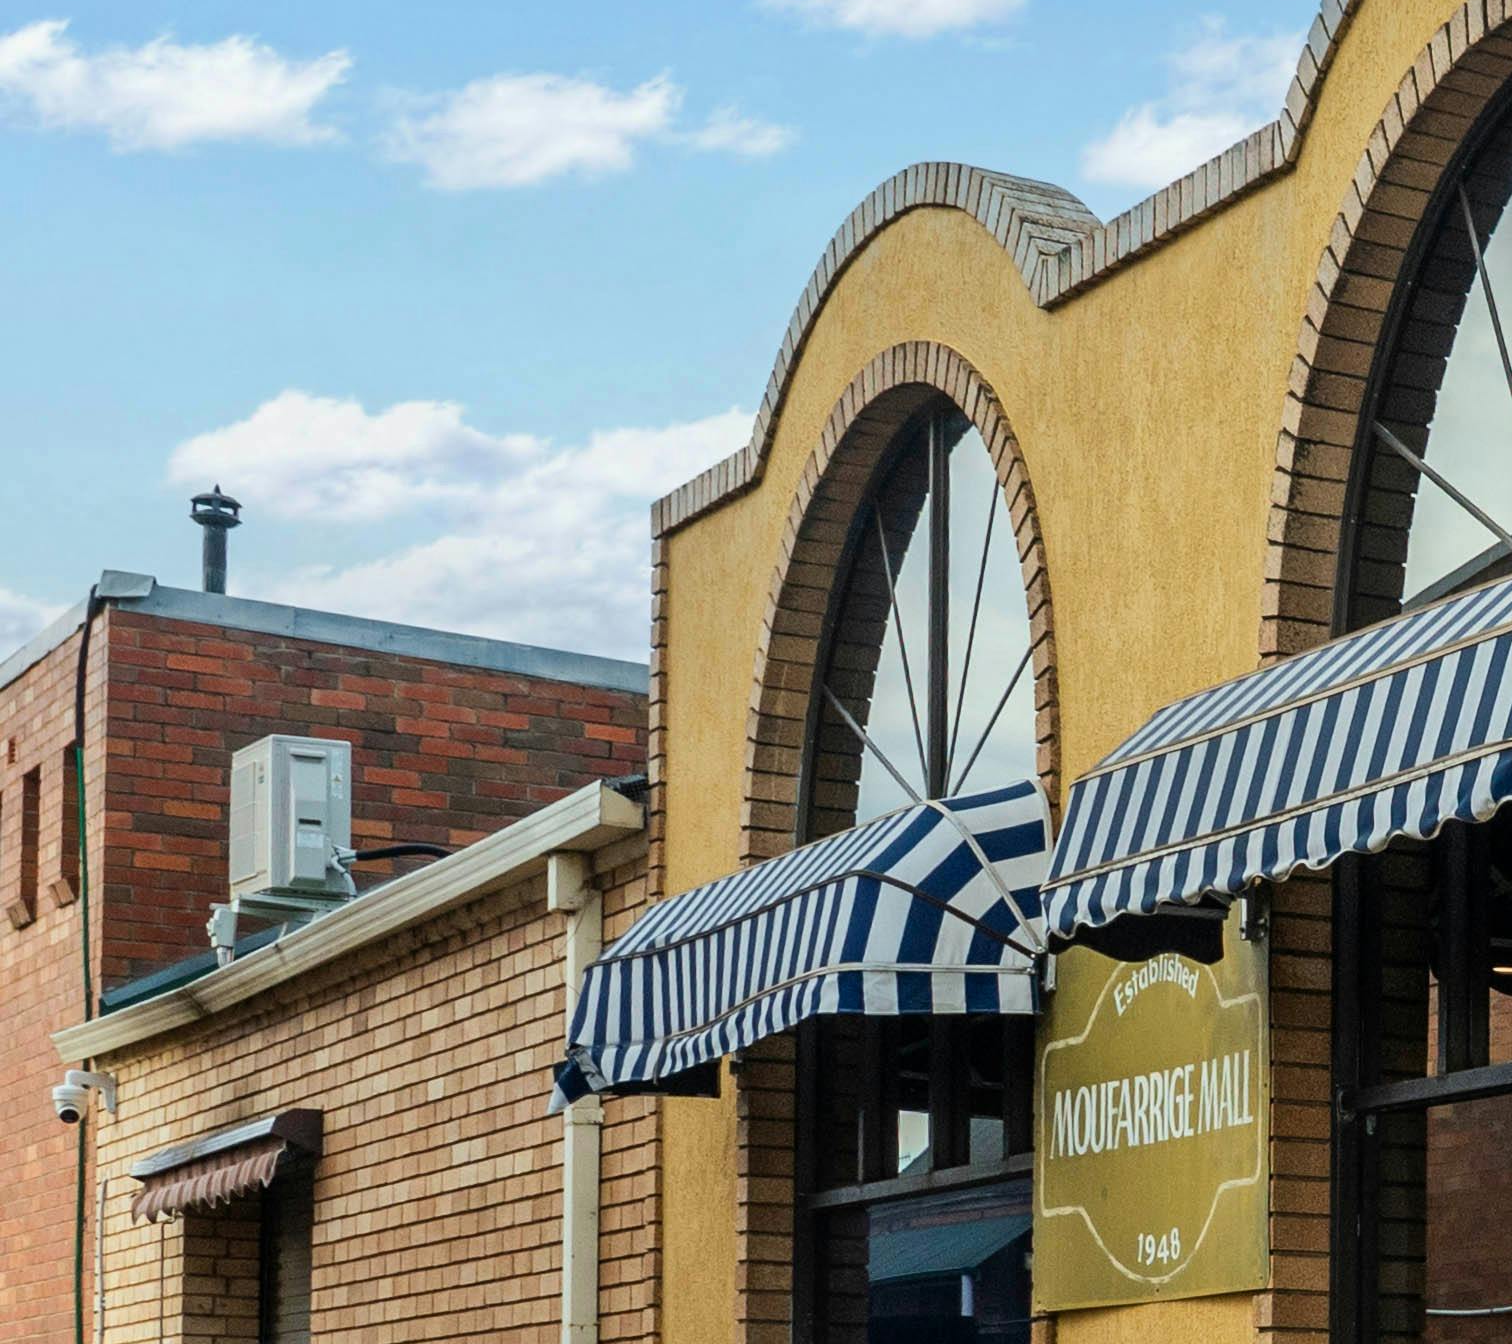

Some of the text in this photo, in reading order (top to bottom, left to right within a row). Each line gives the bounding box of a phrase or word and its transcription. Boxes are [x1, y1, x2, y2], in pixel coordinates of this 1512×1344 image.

[1113, 953, 1199, 1017] Established
[1050, 1049, 1253, 1160] MOUFARRIGE MALL
[1136, 1227, 1181, 1266] 1948
